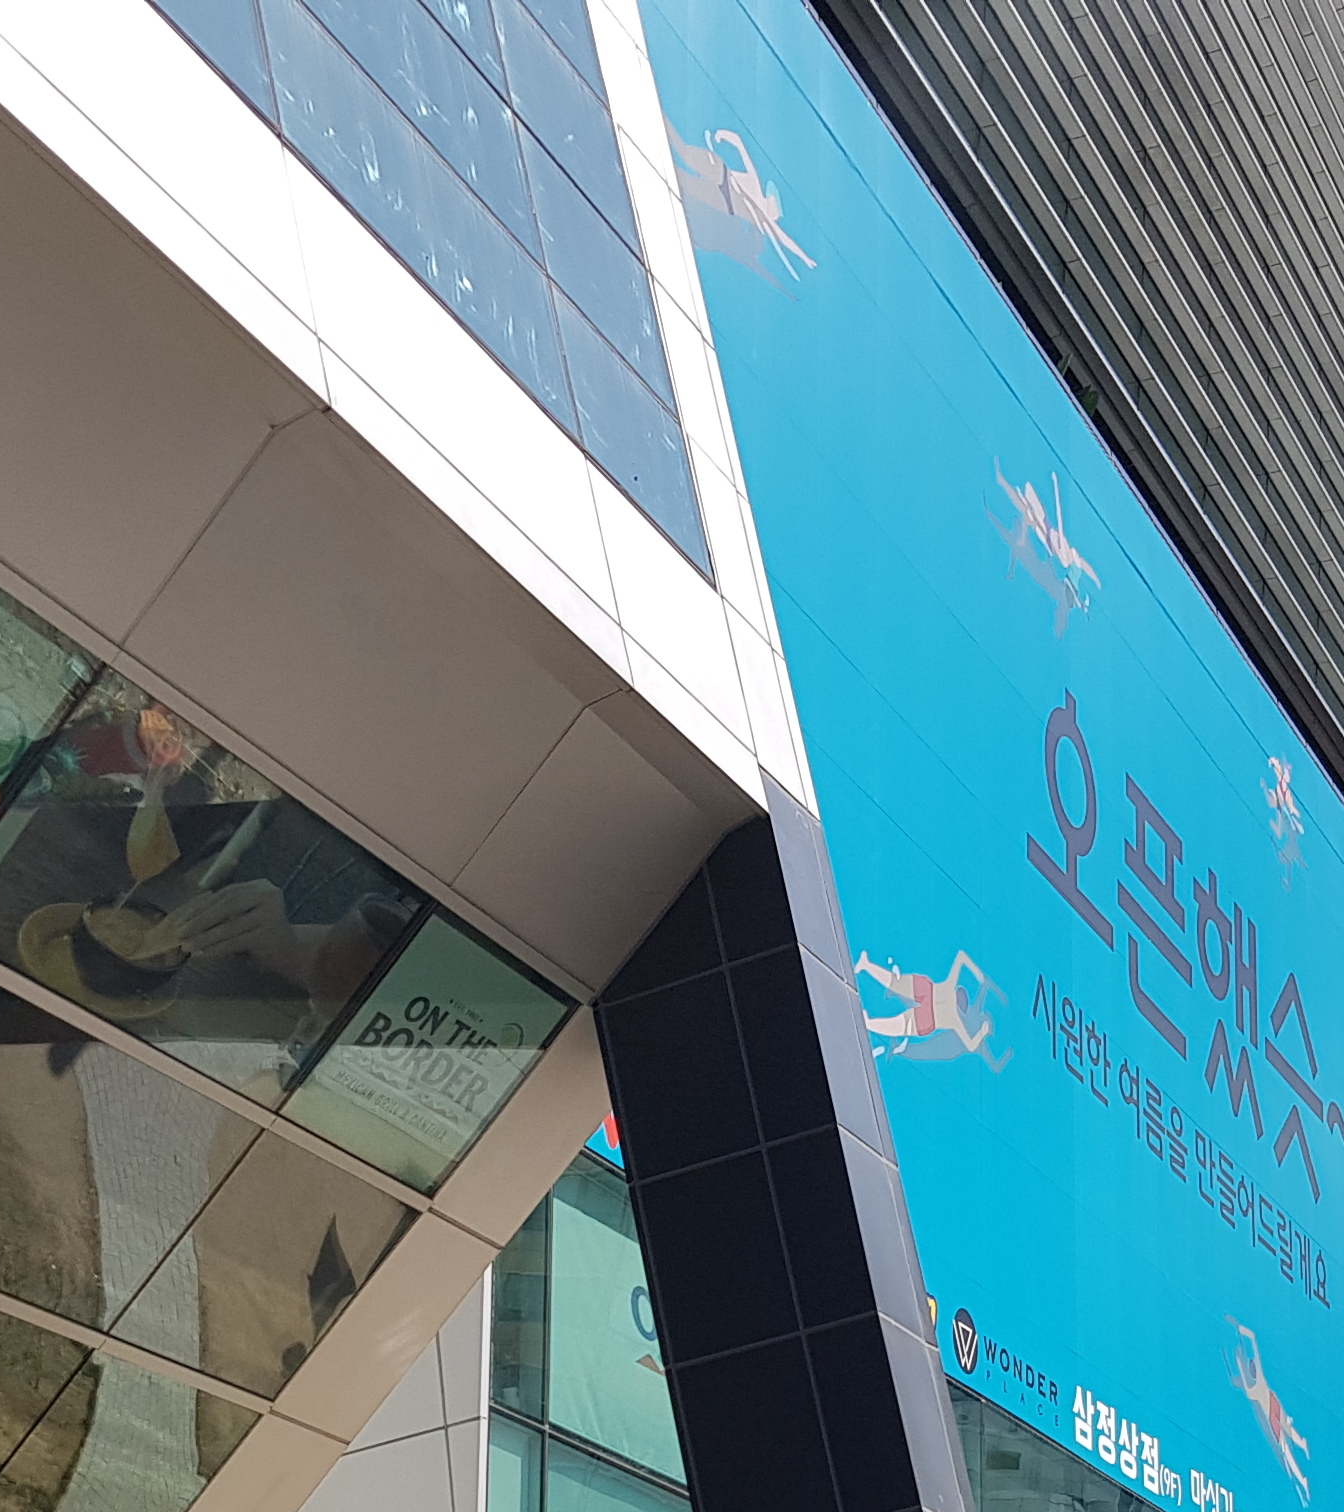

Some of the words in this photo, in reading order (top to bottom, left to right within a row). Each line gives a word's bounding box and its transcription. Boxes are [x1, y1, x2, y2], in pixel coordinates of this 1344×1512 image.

[354, 1010, 489, 1113] BORDER
[404, 996, 450, 1036] ON
[445, 1018, 498, 1066] THE
[1032, 973, 1109, 1107] 시원한
[1120, 1057, 1188, 1184] 여름을
[983, 1334, 1058, 1406] WONDER
[986, 1369, 1060, 1427] PLACE
